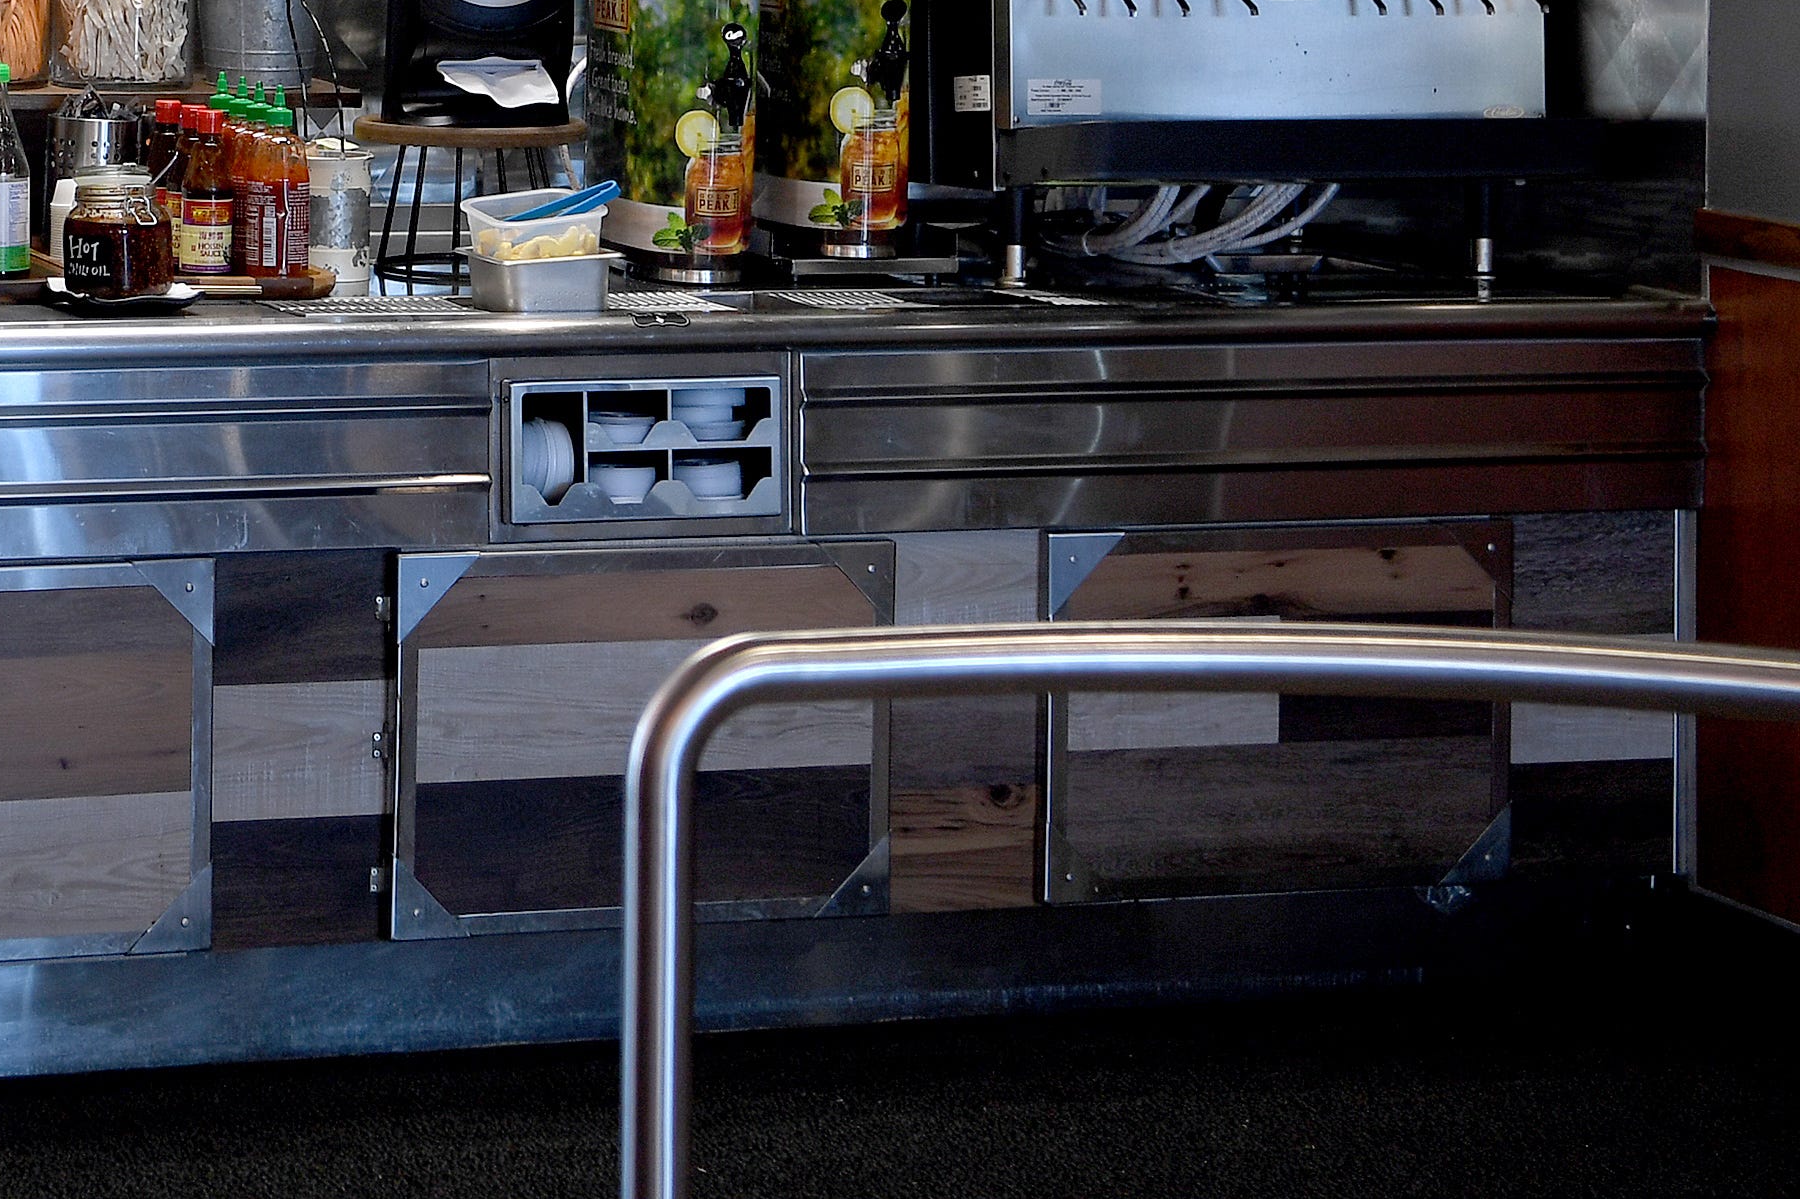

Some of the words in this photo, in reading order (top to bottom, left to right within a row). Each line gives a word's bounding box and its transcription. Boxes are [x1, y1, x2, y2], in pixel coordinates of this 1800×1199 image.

[855, 175, 885, 185] PEAK
[699, 200, 729, 211] PEAK
[198, 242, 224, 250] HOISIN
[91, 265, 110, 277] OIL
